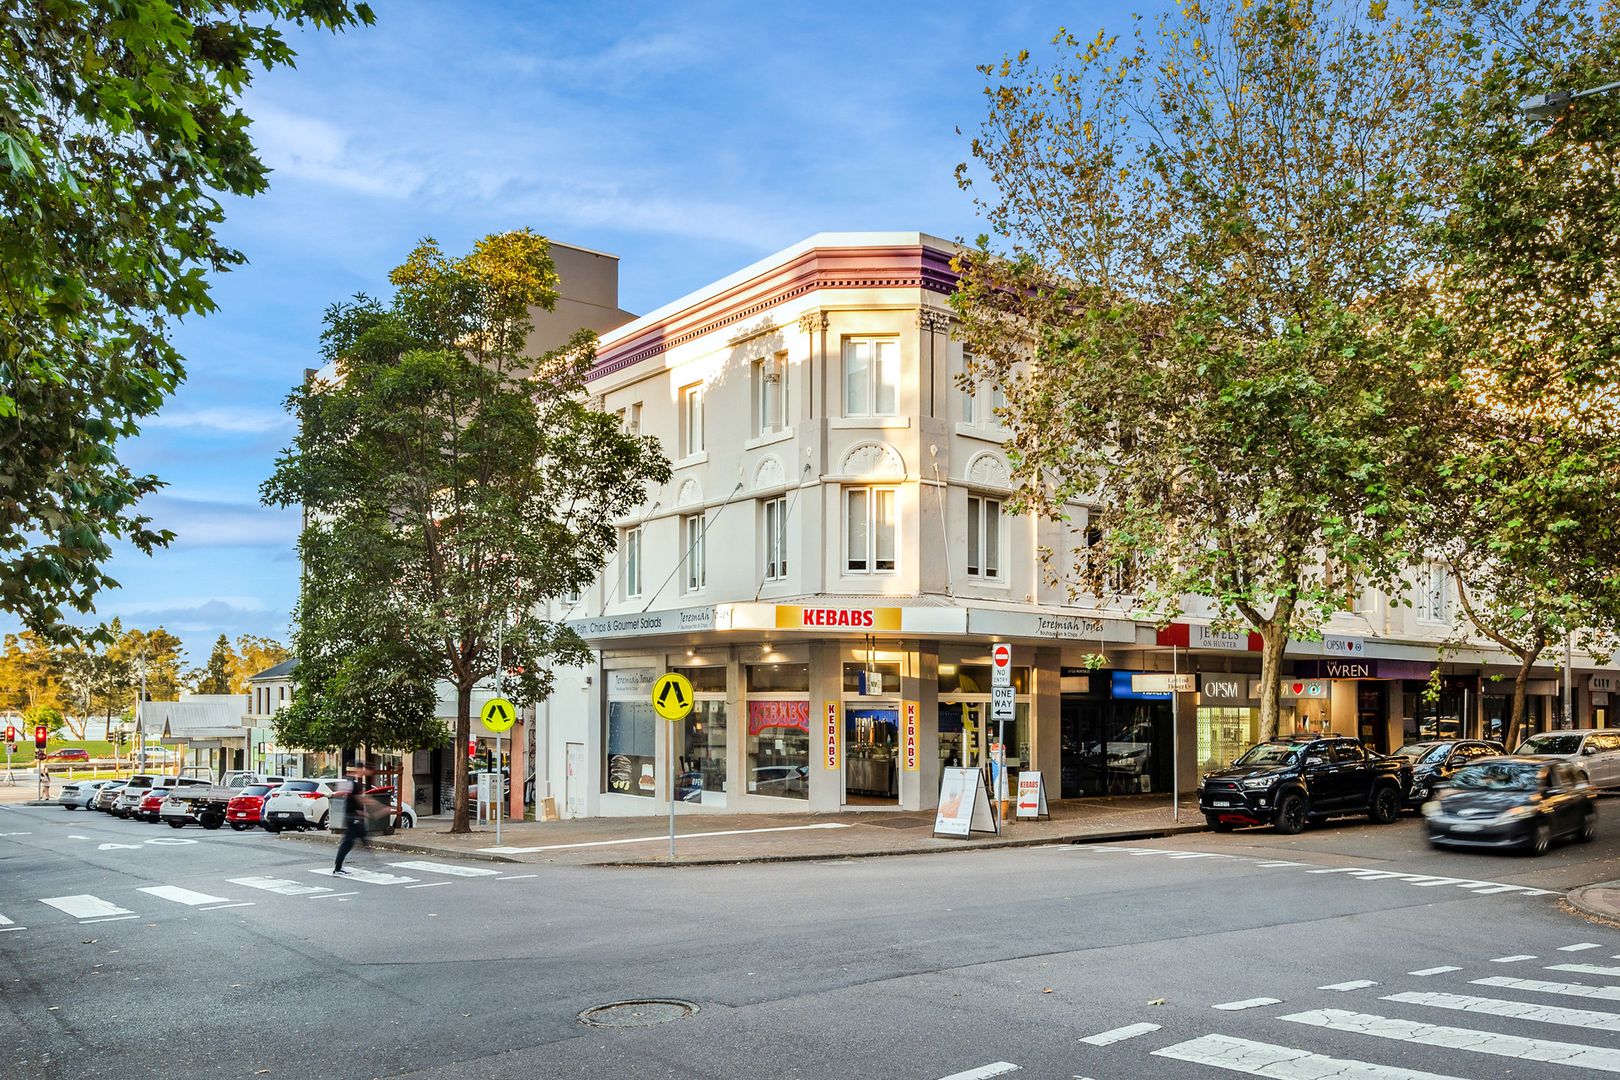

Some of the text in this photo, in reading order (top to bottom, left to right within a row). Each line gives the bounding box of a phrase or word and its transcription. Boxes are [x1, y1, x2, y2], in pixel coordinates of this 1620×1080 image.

[589, 621, 606, 634] Chips
[606, 621, 612, 632] &
[613, 618, 639, 631] Gourmet
[640, 616, 662, 629] Salads
[803, 608, 874, 627] KEBABS
[1035, 616, 1104, 636] Jeremiah Jones
[1203, 639, 1237, 648] ON HUNTER
[1326, 639, 1346, 651] OPSM
[1327, 664, 1369, 677] WREN
[995, 689, 1012, 698] ONE
[1205, 681, 1239, 698] OPSM
[994, 699, 1012, 708] WAY
[748, 700, 809, 733] KEBABS
[828, 704, 836, 766] KEBABS
[907, 705, 915, 768] KEBABS
[1020, 780, 1039, 788] KEBABS
